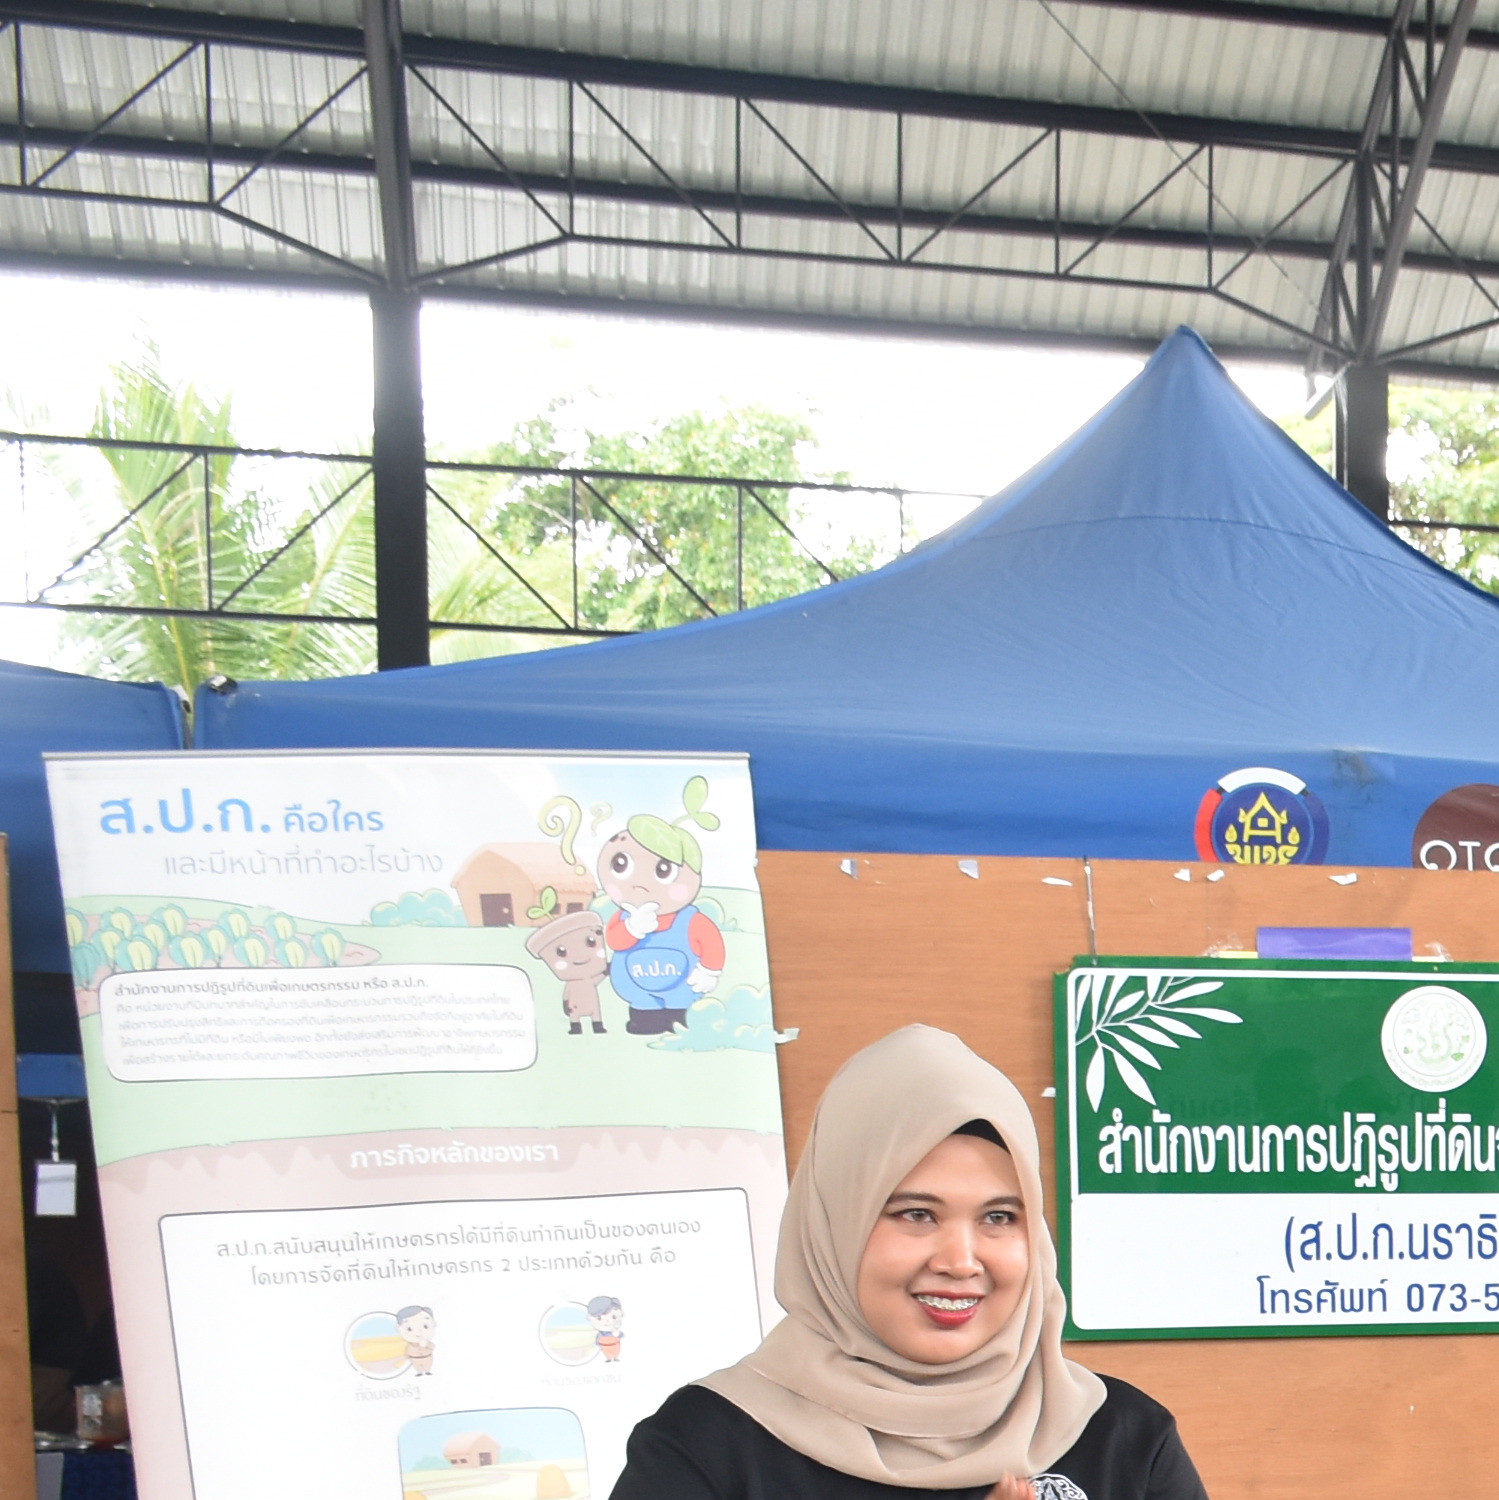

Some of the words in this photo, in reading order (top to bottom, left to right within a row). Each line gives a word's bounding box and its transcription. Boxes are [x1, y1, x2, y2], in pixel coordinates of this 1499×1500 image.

[100, 787, 272, 835] ส.ป.ก.
[283, 798, 385, 833] คือใคร
[164, 844, 444, 876] และมีหน้าที่ทำอะไรบ้าง
[350, 1140, 560, 1170] ภารกิจหลักของเรา
[501, 1258, 512, 1272] 2
[650, 1246, 677, 1264] คือ
[1256, 1276, 1388, 1314] โทรศัพท์
